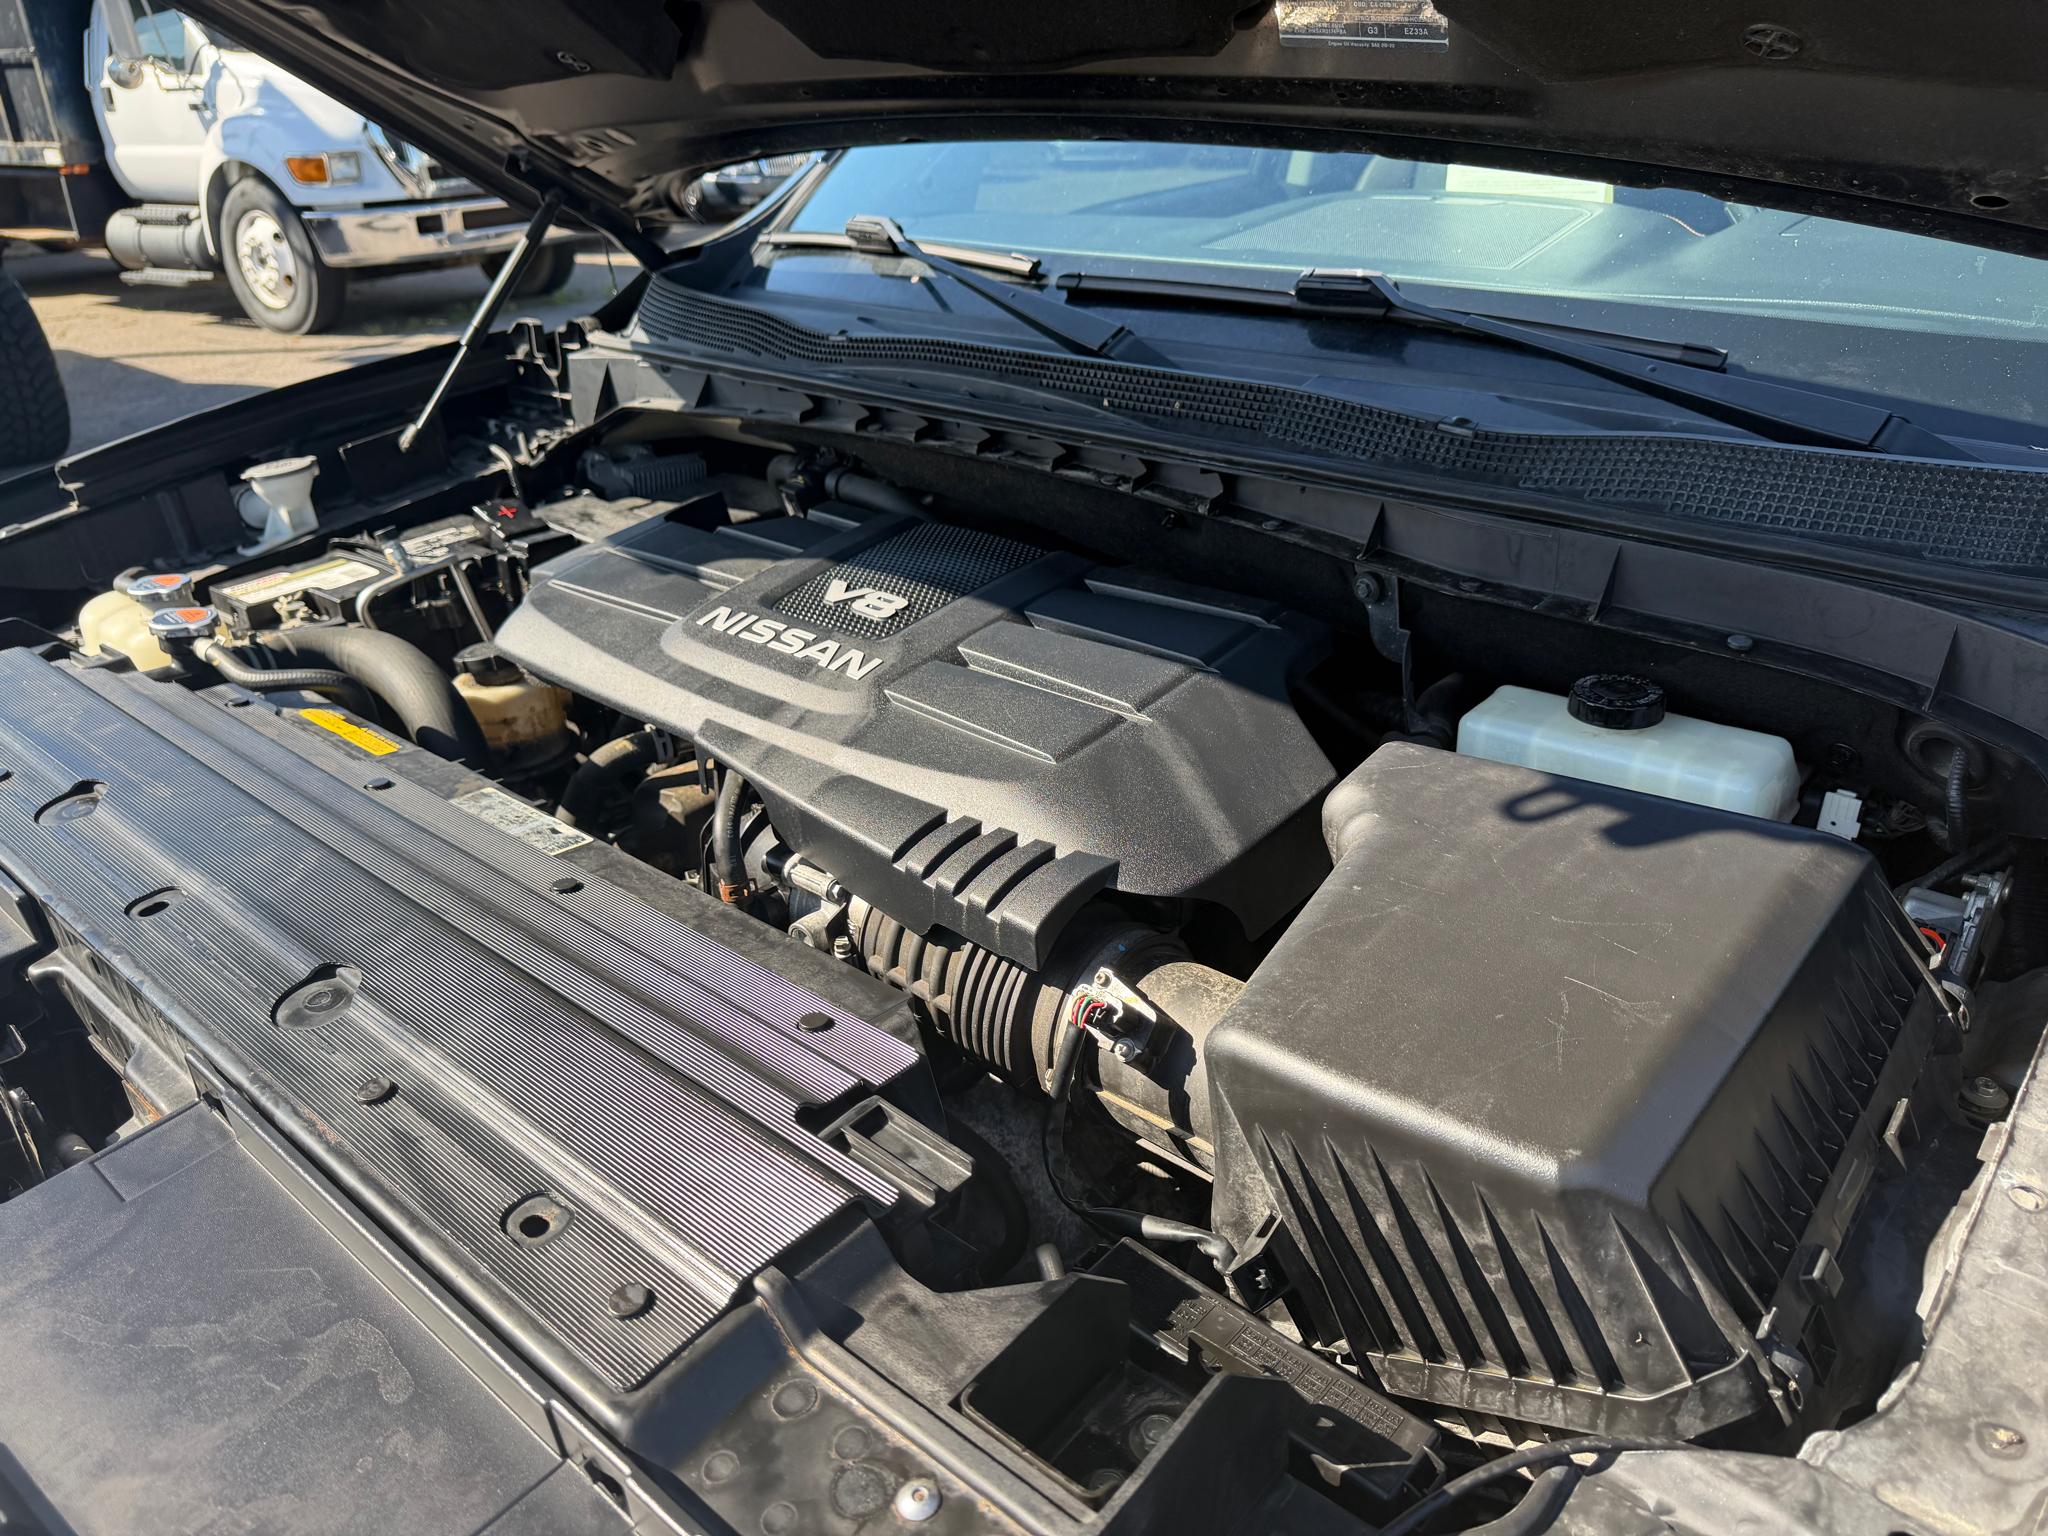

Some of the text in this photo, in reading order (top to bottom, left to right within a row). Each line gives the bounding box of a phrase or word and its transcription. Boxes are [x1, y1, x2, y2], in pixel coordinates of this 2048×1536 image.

[1367, 26, 1378, 34] G3
[1404, 27, 1429, 36] EZ33A
[824, 579, 909, 621] V8
[696, 606, 884, 681] NISSAN
